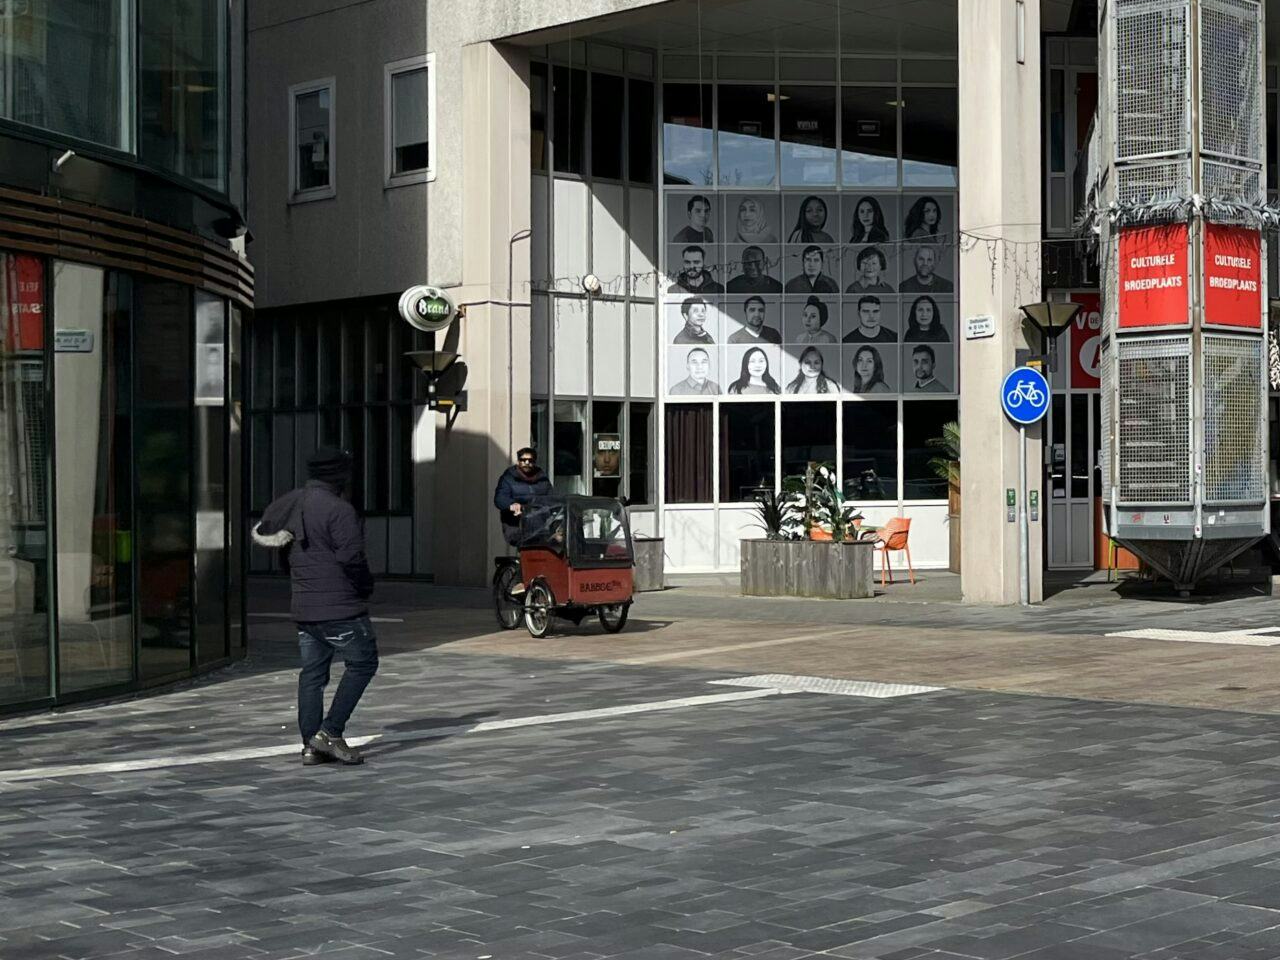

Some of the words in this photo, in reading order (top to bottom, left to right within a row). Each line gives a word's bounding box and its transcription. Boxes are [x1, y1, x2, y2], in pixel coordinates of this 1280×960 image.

[1130, 253, 1175, 269] CULTURELE
[1214, 254, 1252, 269] CULTURELE
[1124, 275, 1182, 292] BROEDPLAATS
[1209, 276, 1257, 292] BROEDPLAATS
